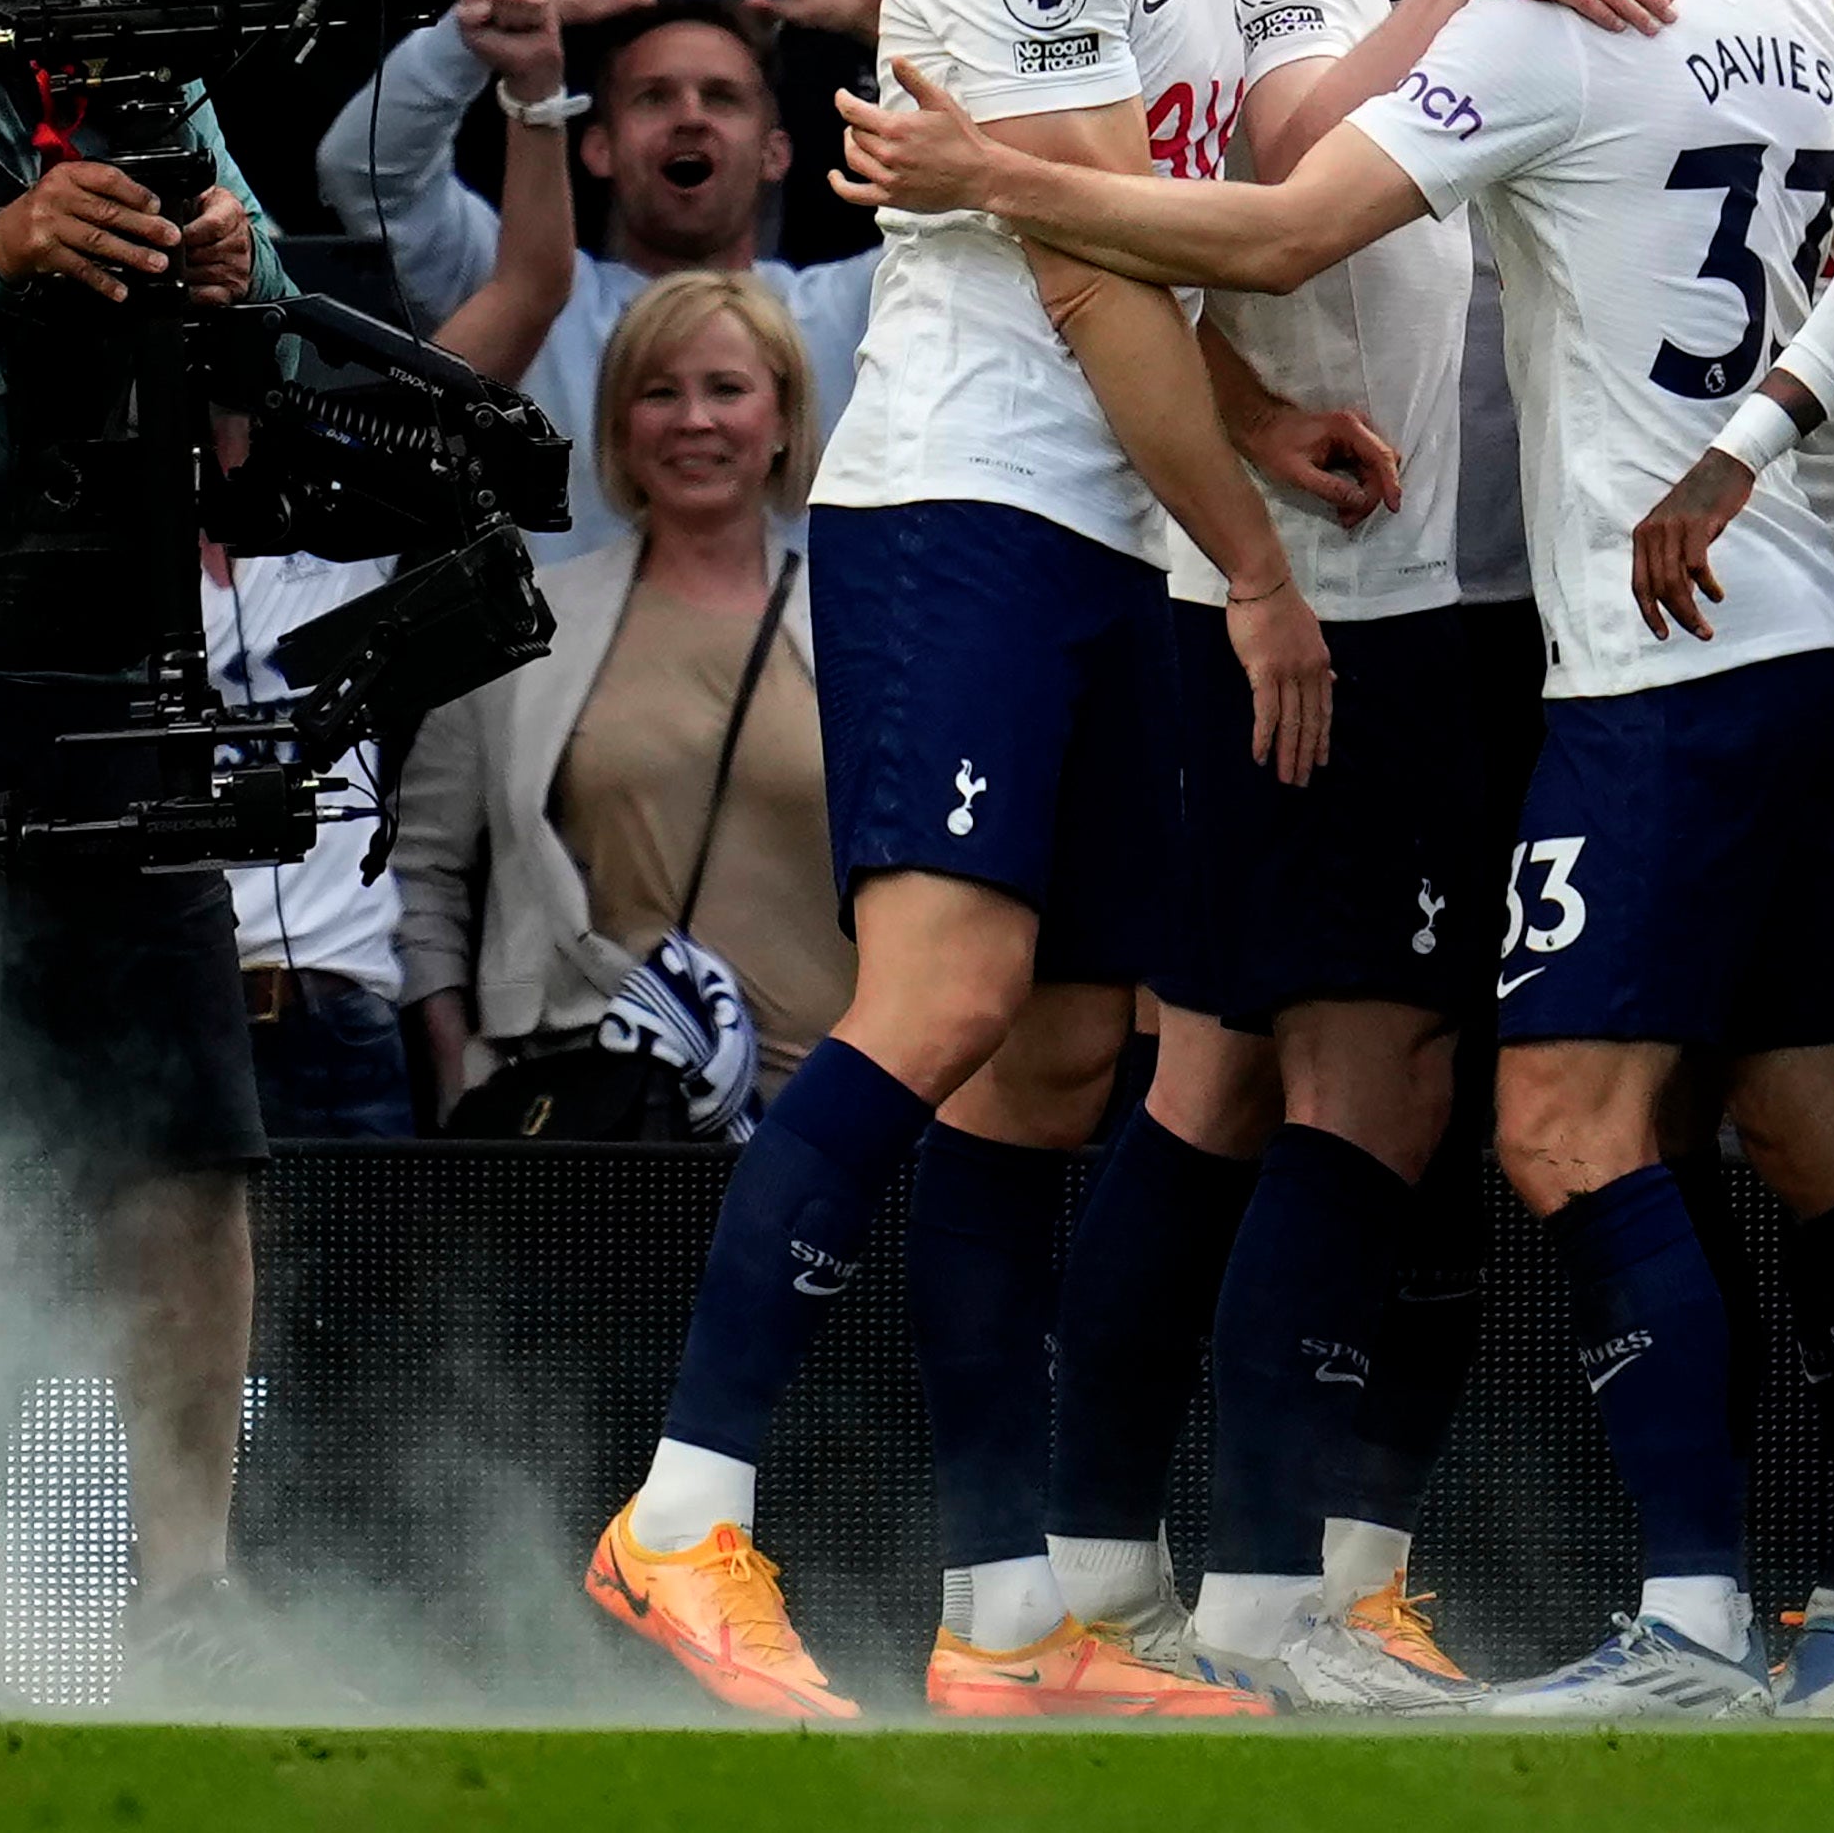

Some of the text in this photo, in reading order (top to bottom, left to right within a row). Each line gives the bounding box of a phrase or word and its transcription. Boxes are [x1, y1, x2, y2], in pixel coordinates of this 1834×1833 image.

[1264, 8, 1316, 28] room
[1014, 36, 1093, 59] No room
[1016, 51, 1100, 74] for racism
[1686, 35, 1834, 106] DAVIES
